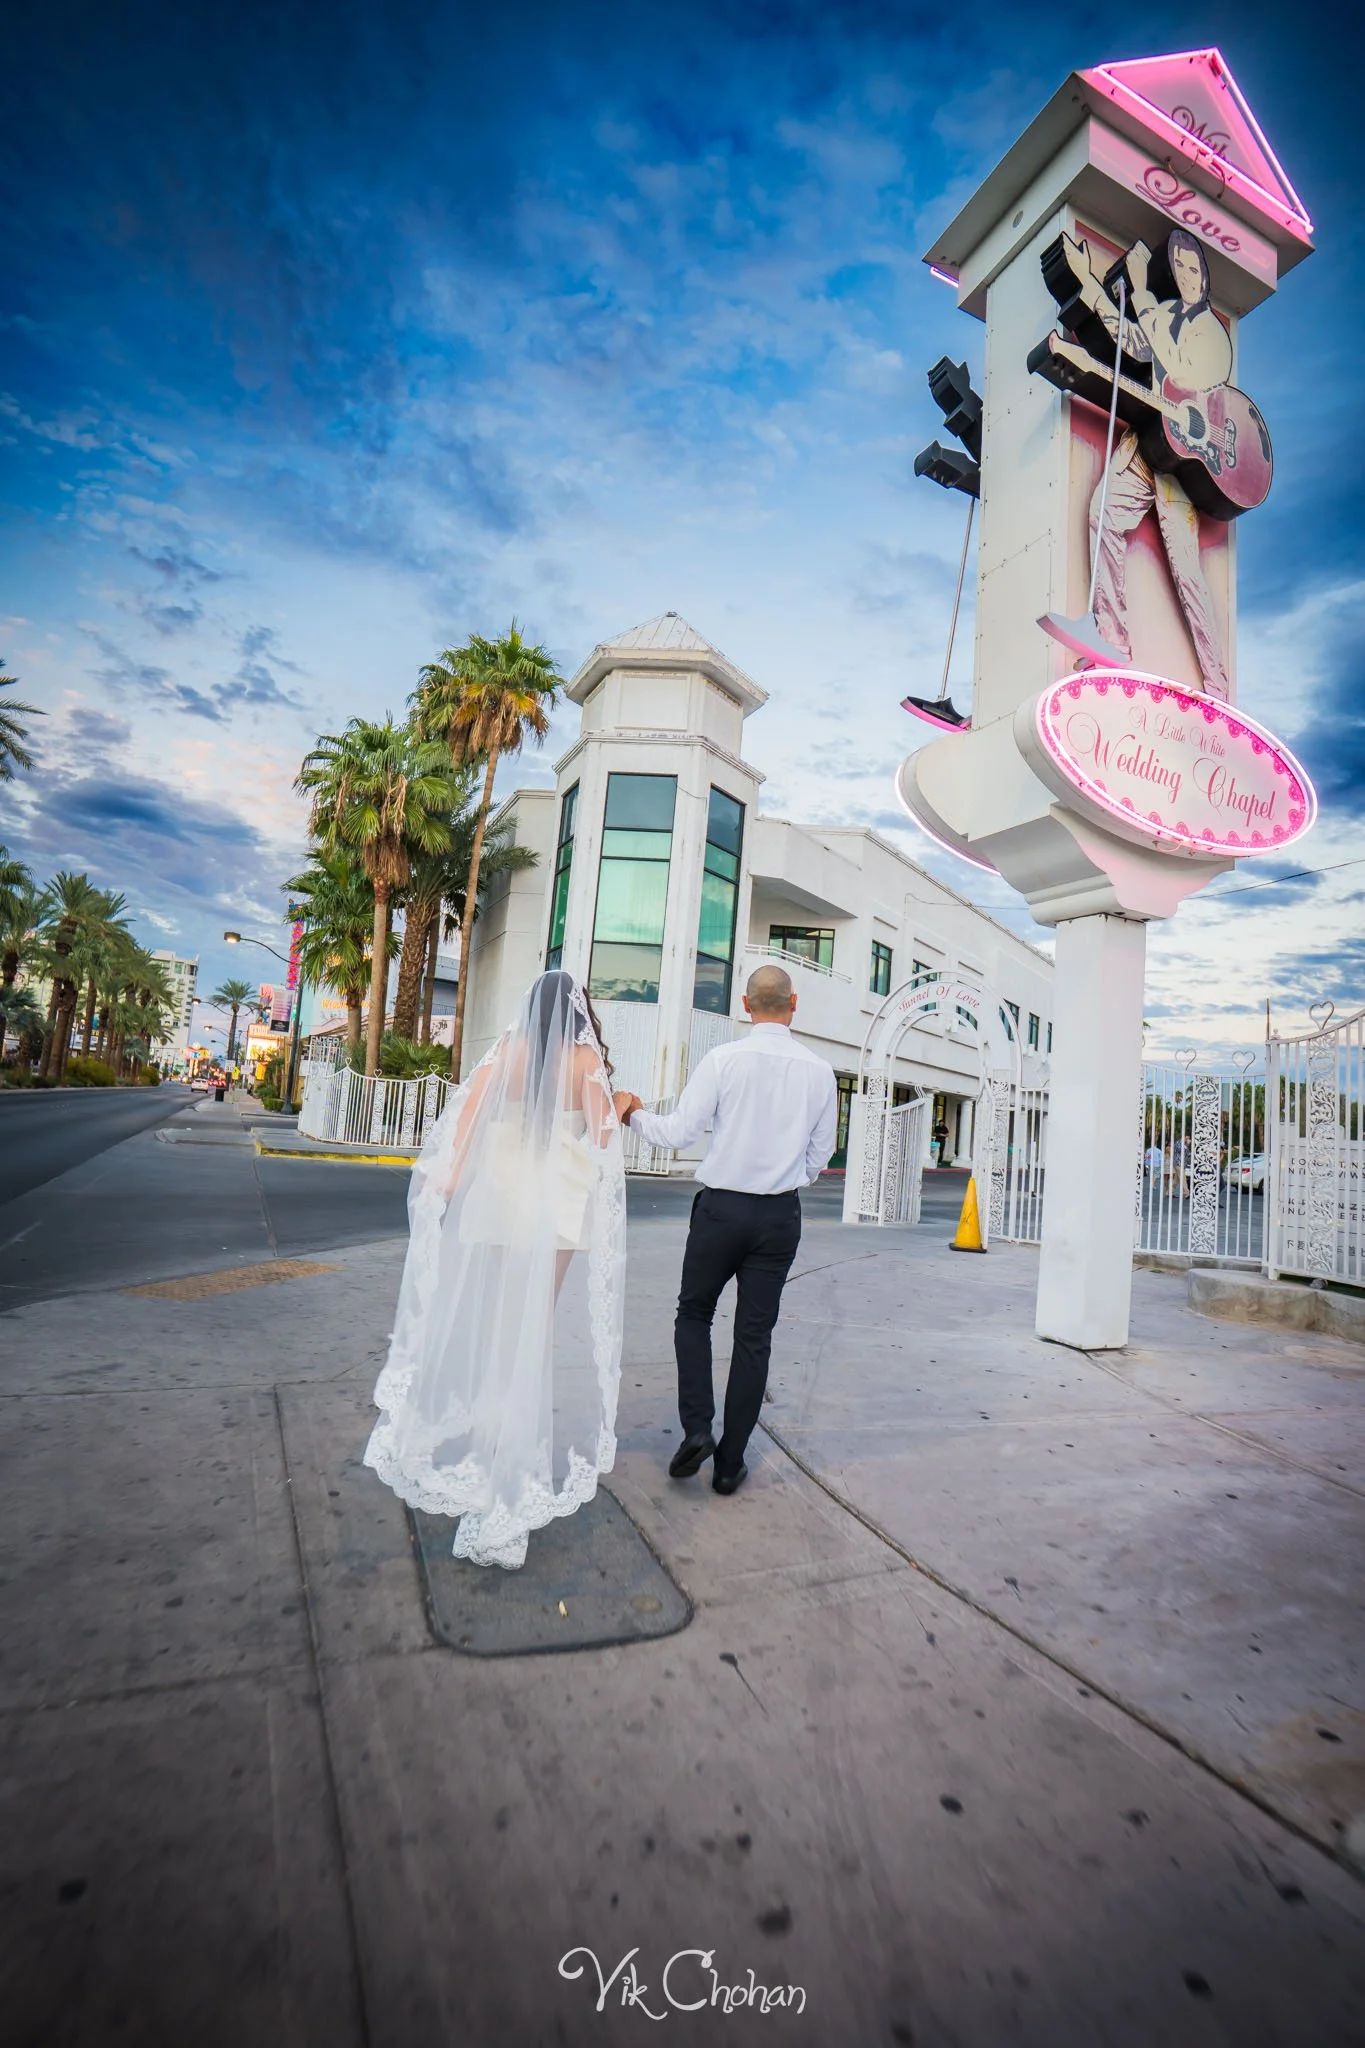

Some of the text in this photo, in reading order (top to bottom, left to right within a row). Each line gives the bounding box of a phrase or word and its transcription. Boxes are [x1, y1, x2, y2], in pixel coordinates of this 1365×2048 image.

[1135, 166, 1241, 252] Love
[1128, 705, 1226, 758] A Little White
[1066, 711, 1276, 827] Wedding Chapel
[898, 986, 981, 1012] Tunnel Of Love
